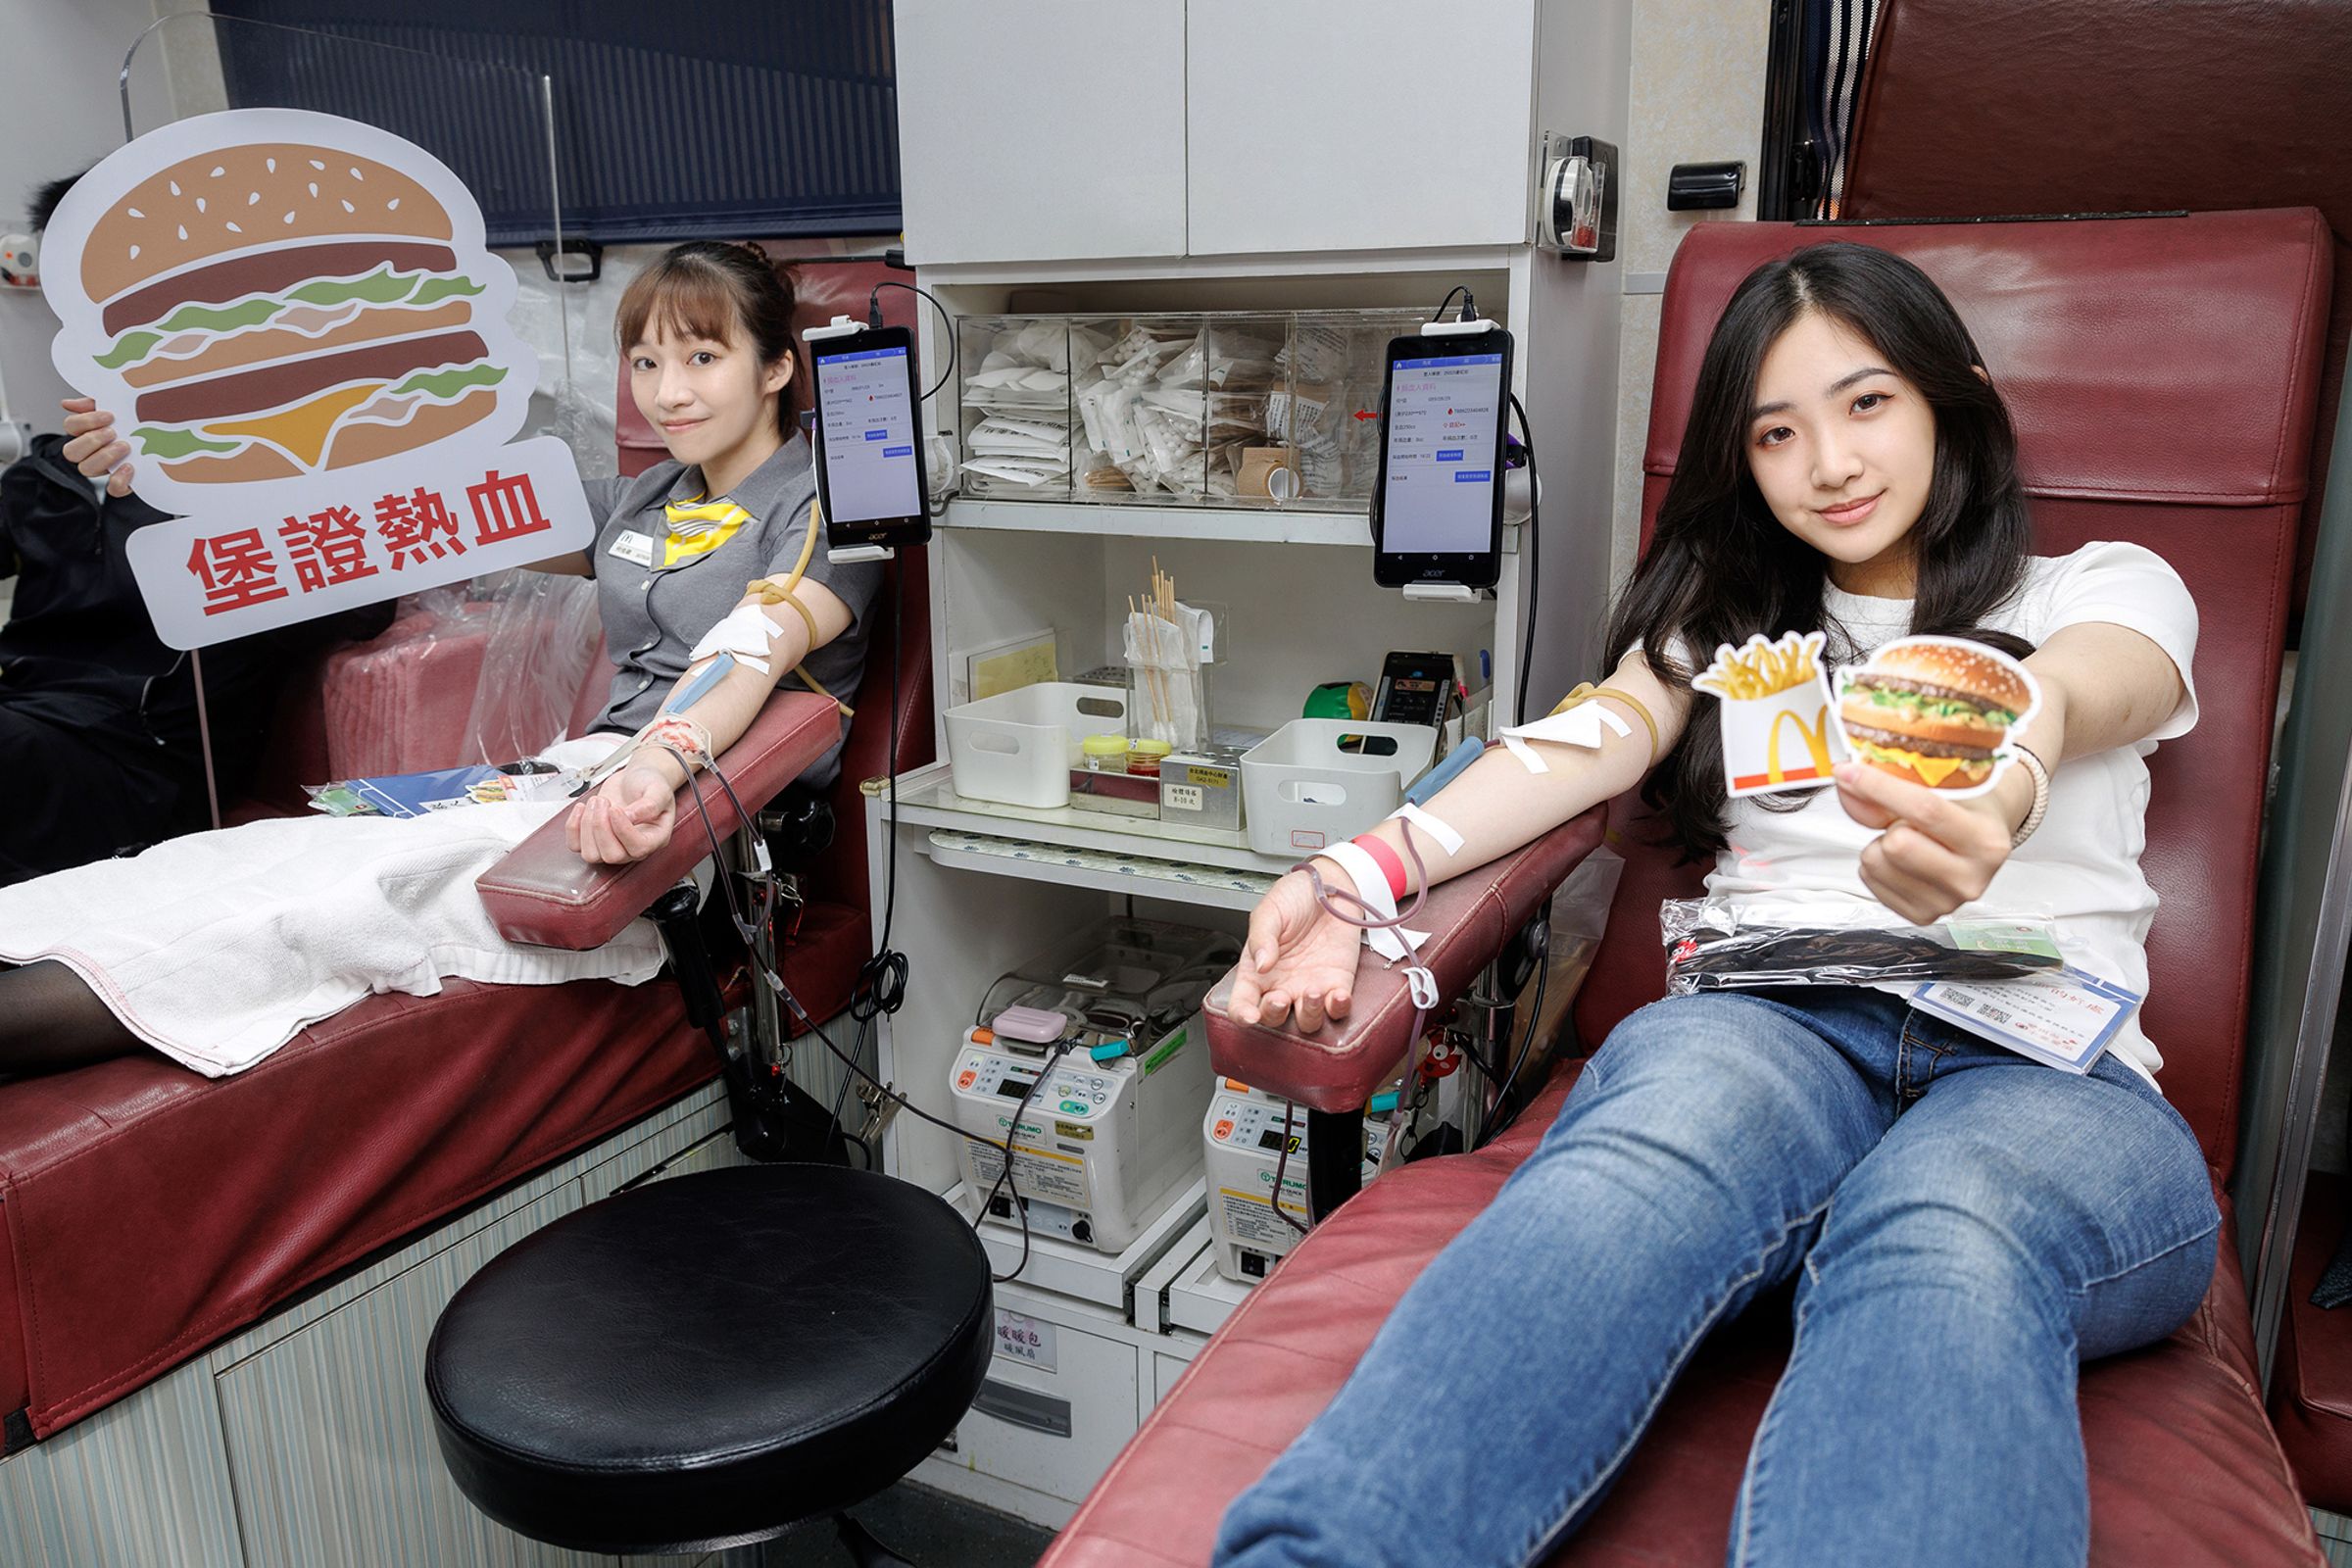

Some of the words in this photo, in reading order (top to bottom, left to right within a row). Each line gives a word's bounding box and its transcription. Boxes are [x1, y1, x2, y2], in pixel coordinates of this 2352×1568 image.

[187, 469, 552, 617] 堡證熱血
[868, 532, 887, 541] acer
[1006, 1119, 1042, 1135] TRUMO
[1269, 1176, 1306, 1191] TRUMO
